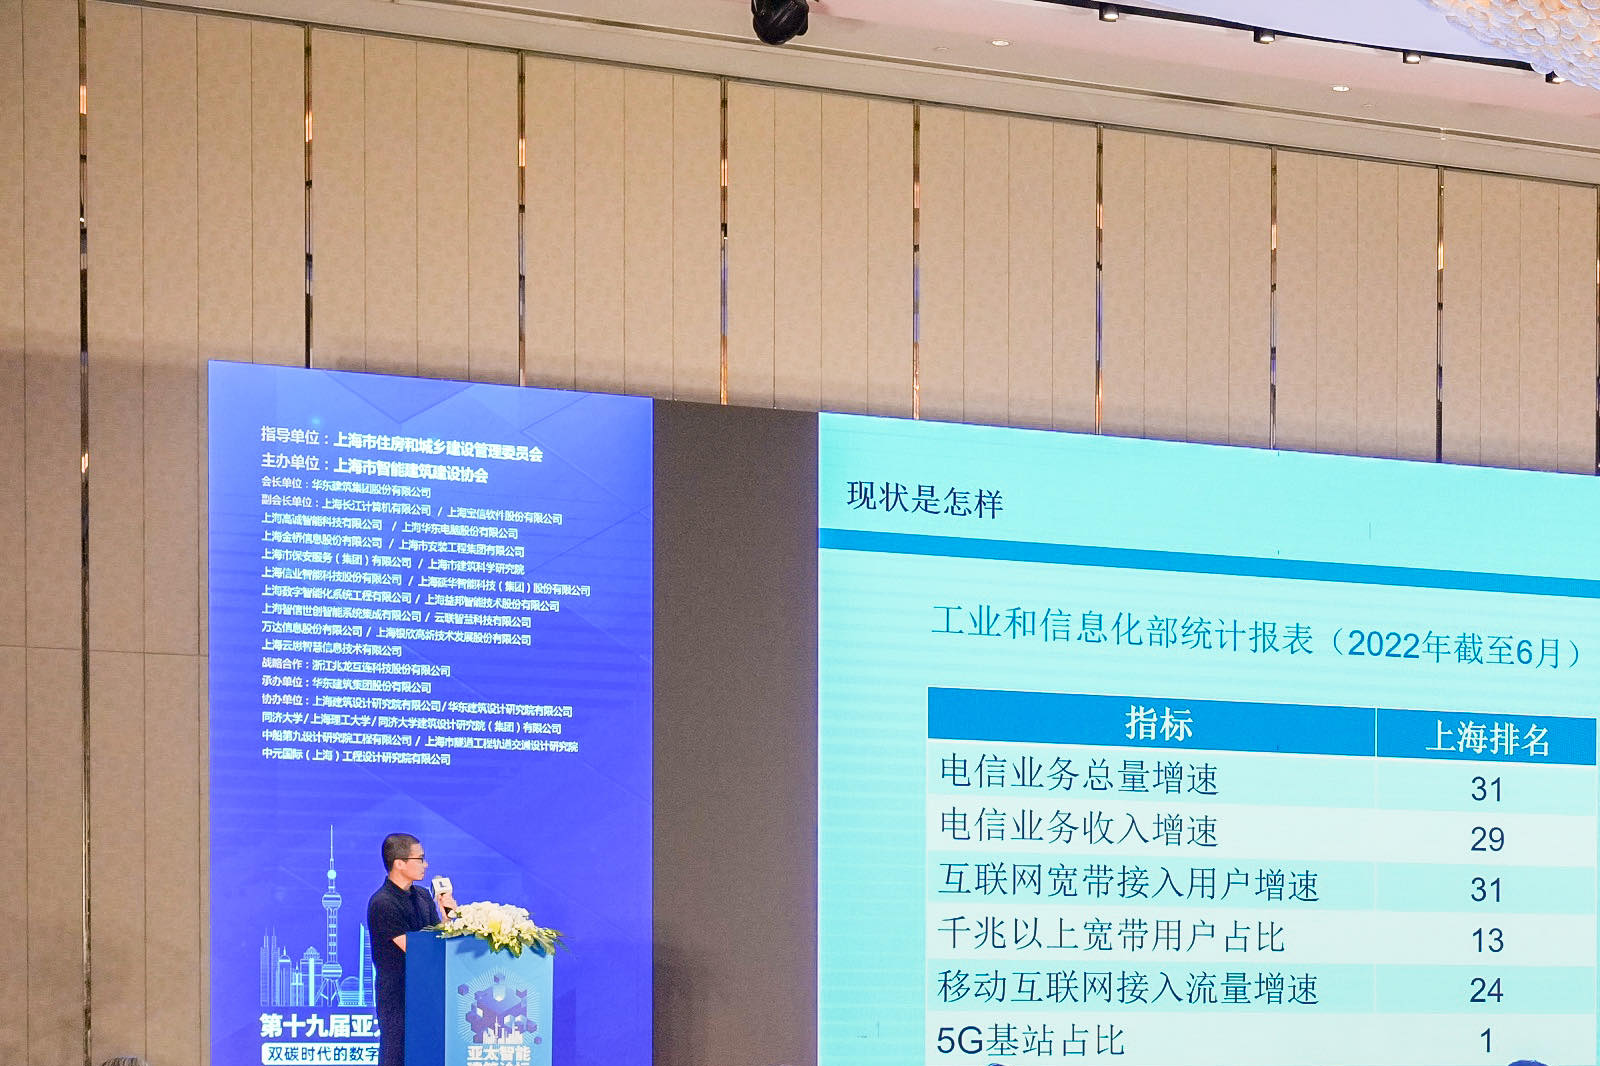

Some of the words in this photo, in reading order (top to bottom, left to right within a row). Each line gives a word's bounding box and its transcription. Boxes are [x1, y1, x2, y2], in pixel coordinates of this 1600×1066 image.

[846, 479, 1004, 520] 现状是怎样
[931, 605, 1582, 671] 工业和信息化部统计报表（2022年截至6月）
[1125, 705, 1193, 743] 指标
[1425, 720, 1551, 758] 上海排名
[939, 752, 1219, 797] 电信业务总量增速
[1470, 775, 1502, 803] 31
[939, 806, 1219, 848] 电信业务收入增速
[1470, 826, 1505, 853] 29
[937, 861, 1320, 903] 互联网宽带接入用户增速
[1470, 876, 1501, 904] 31
[937, 916, 1286, 954] 千兆以上宽带用户占比
[1472, 927, 1505, 954] 13
[937, 970, 1320, 1007] 移动互联网接入流量增速
[1469, 977, 1505, 1004] 24
[267, 1046, 379, 1062] 双碳时代的数字
[467, 1045, 531, 1061] 亚太智能
[936, 1023, 1126, 1059] 5G基站占比
[1479, 1027, 1492, 1053] 1
